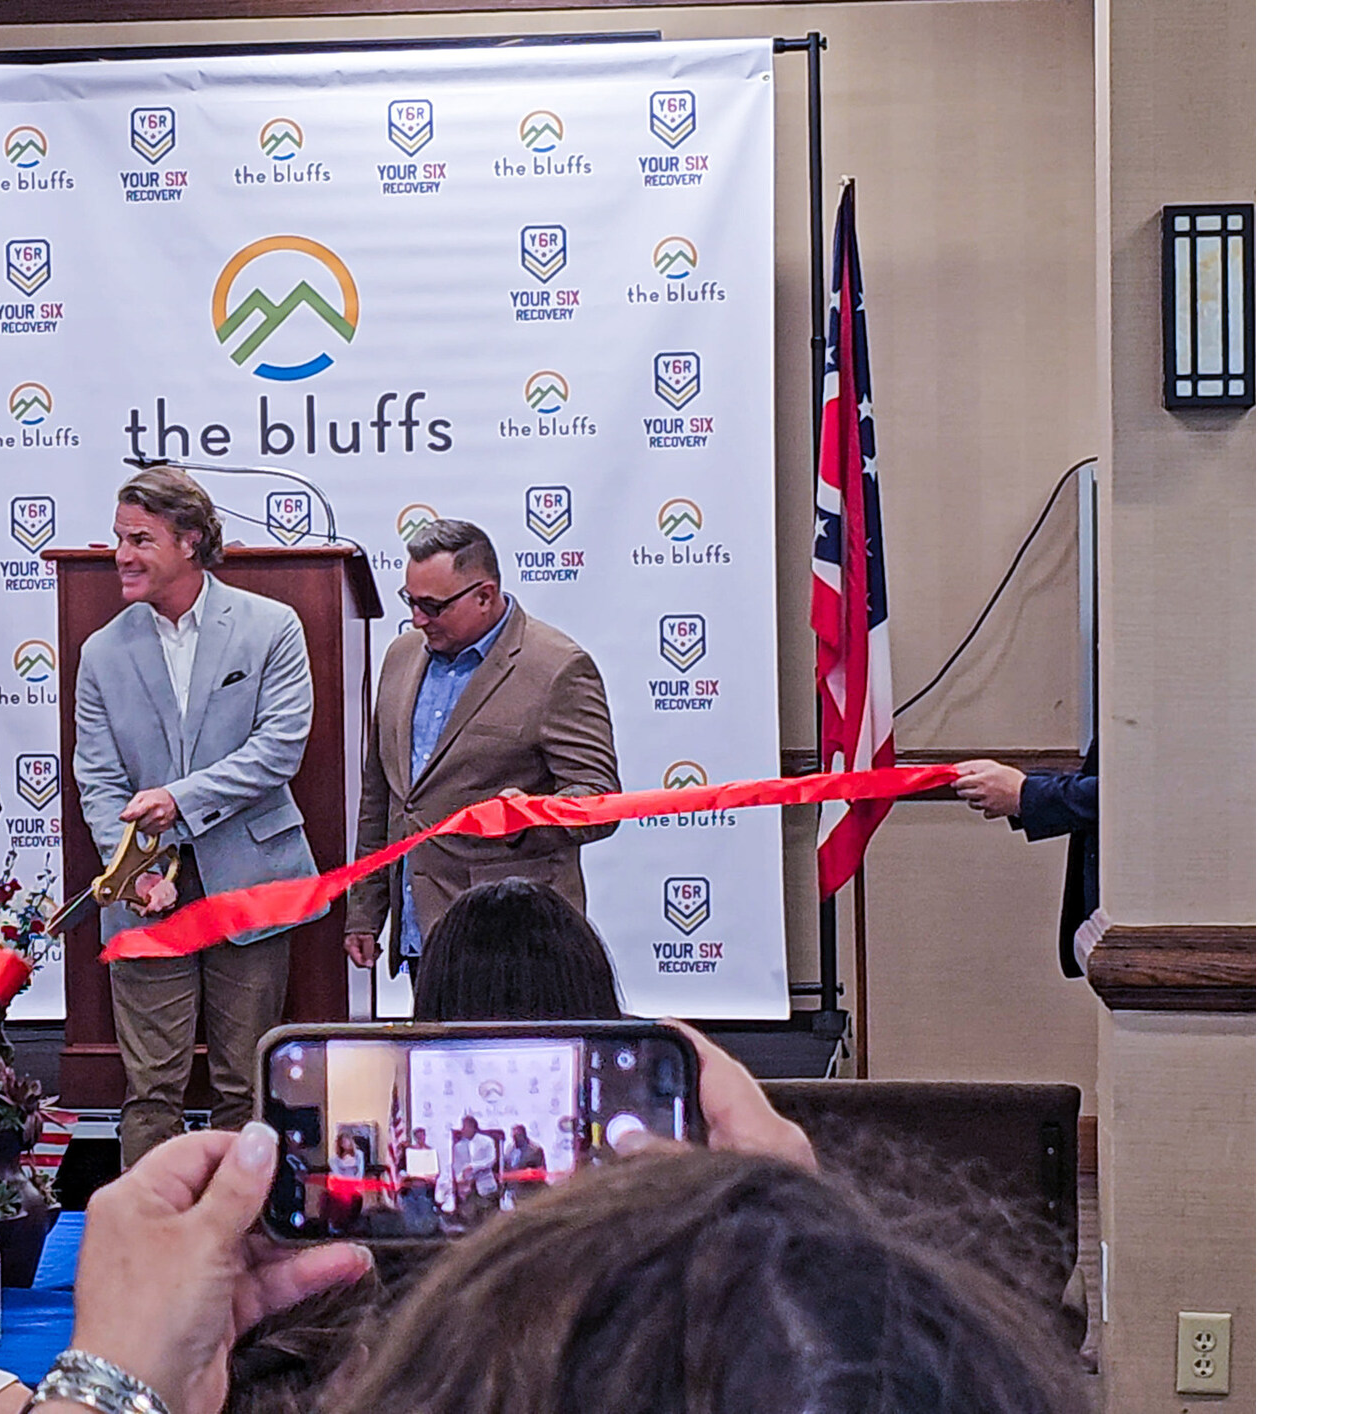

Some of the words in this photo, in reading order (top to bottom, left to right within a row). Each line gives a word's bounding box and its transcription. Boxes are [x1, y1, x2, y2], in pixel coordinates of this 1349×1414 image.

[659, 98, 686, 112] Y6R
[139, 114, 166, 129] Y6R
[397, 107, 424, 120] Y6R
[377, 164, 417, 180] YOUR
[423, 163, 446, 179] SIX
[494, 158, 525, 176] the
[534, 155, 591, 175] bluffs
[639, 157, 679, 173] YOUR
[685, 156, 708, 171] SIX
[18, 171, 74, 190] bluffs
[120, 172, 159, 188] YOUR
[165, 171, 187, 186] SIX
[235, 166, 266, 184] the
[274, 162, 330, 182] bluffs
[643, 174, 702, 186] RECOVERY
[126, 189, 182, 201] RECOVERY
[383, 182, 440, 194] RECOVERY
[529, 232, 558, 248] Y6R
[15, 247, 42, 261] Y6R
[510, 291, 550, 307] YOUR
[557, 290, 579, 305] SIX
[628, 285, 659, 303] the
[668, 282, 725, 301] bluffs
[41, 303, 63, 318] SIX
[516, 308, 573, 321] RECOVERY
[2, 321, 57, 333] RECOVERY
[663, 360, 691, 374] Y6R
[124, 398, 231, 458] the
[260, 392, 453, 456] bluffs
[500, 419, 531, 437] the
[539, 416, 596, 435] bluffs
[644, 418, 684, 434] YOUR
[690, 418, 713, 433] SIX
[23, 426, 79, 446] bluffs
[649, 435, 707, 448] RECOVERY
[274, 498, 302, 514] Y6R
[534, 493, 562, 508] Y6R
[19, 504, 46, 518] Y6R
[372, 551, 403, 570] the
[515, 552, 555, 567] YOUR
[561, 551, 584, 566] SIX
[633, 547, 664, 564] the
[673, 544, 730, 563] bluffs
[0, 561, 39, 577] YOUR
[521, 569, 578, 581] RECOVERY
[6, 578, 55, 590] RECOVER
[669, 622, 697, 636] Y6R
[26, 686, 56, 704] blu
[649, 681, 689, 696] YOUR
[696, 680, 719, 695] SIX
[655, 698, 713, 710] RECOVERY
[24, 761, 52, 777] Y6R
[676, 808, 736, 826] bluffs
[6, 819, 46, 834] YOUR
[11, 836, 59, 848] RECOVER
[672, 885, 701, 900] Y6R
[653, 943, 693, 959] YOUR
[699, 943, 722, 958] SIX
[659, 960, 717, 973] RECOVERY
